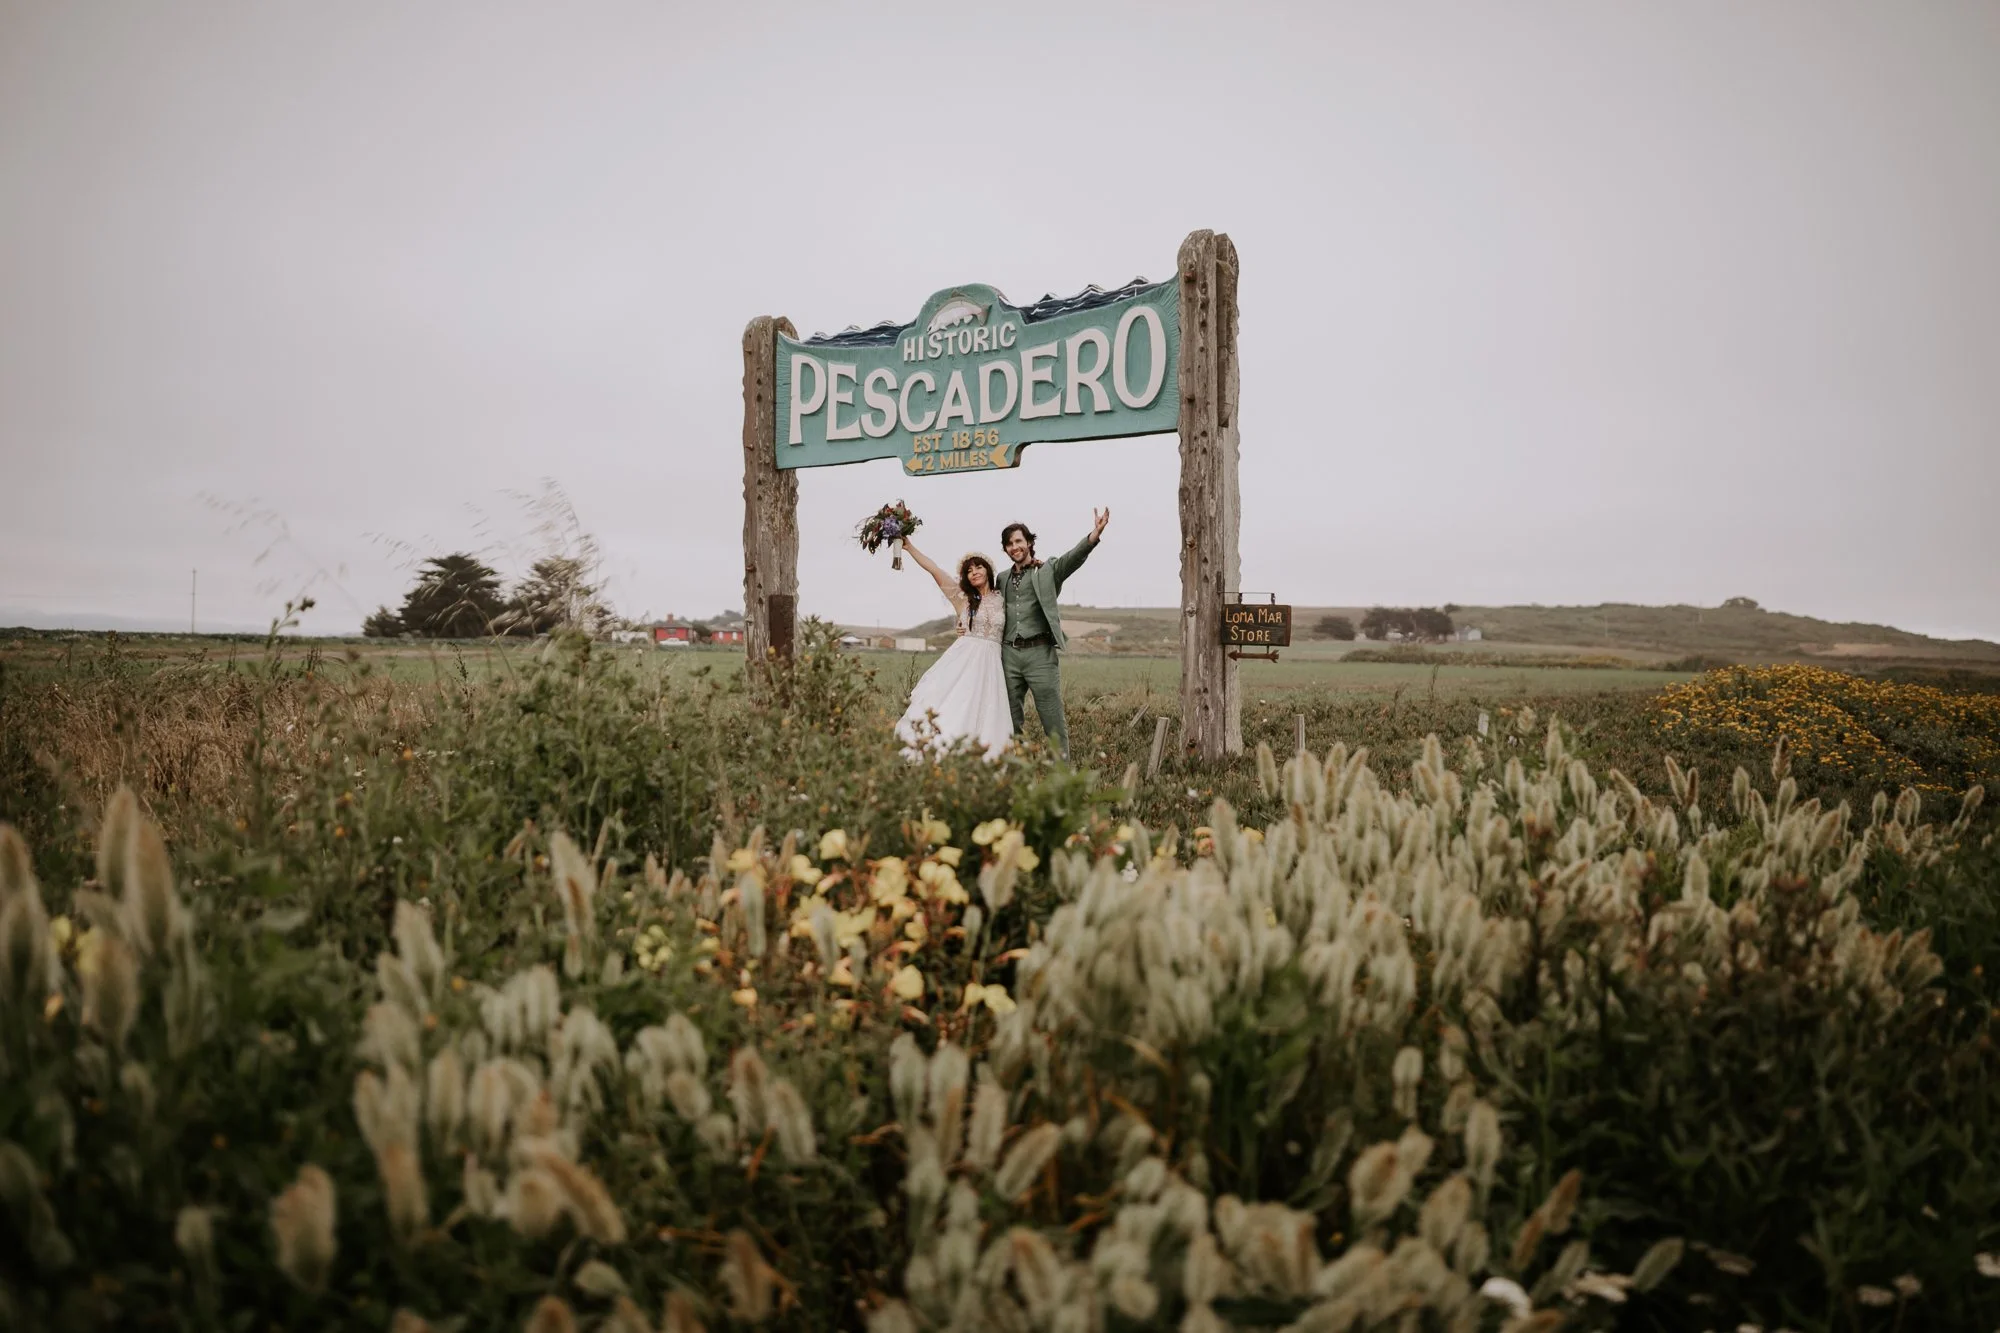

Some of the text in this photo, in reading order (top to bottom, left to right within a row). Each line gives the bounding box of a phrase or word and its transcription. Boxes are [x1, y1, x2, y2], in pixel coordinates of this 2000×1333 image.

[903, 323, 1017, 362] HISTORIC
[789, 306, 1166, 445] PESCADERO
[913, 427, 999, 454] EST 1856
[924, 450, 988, 471] 2 MILES
